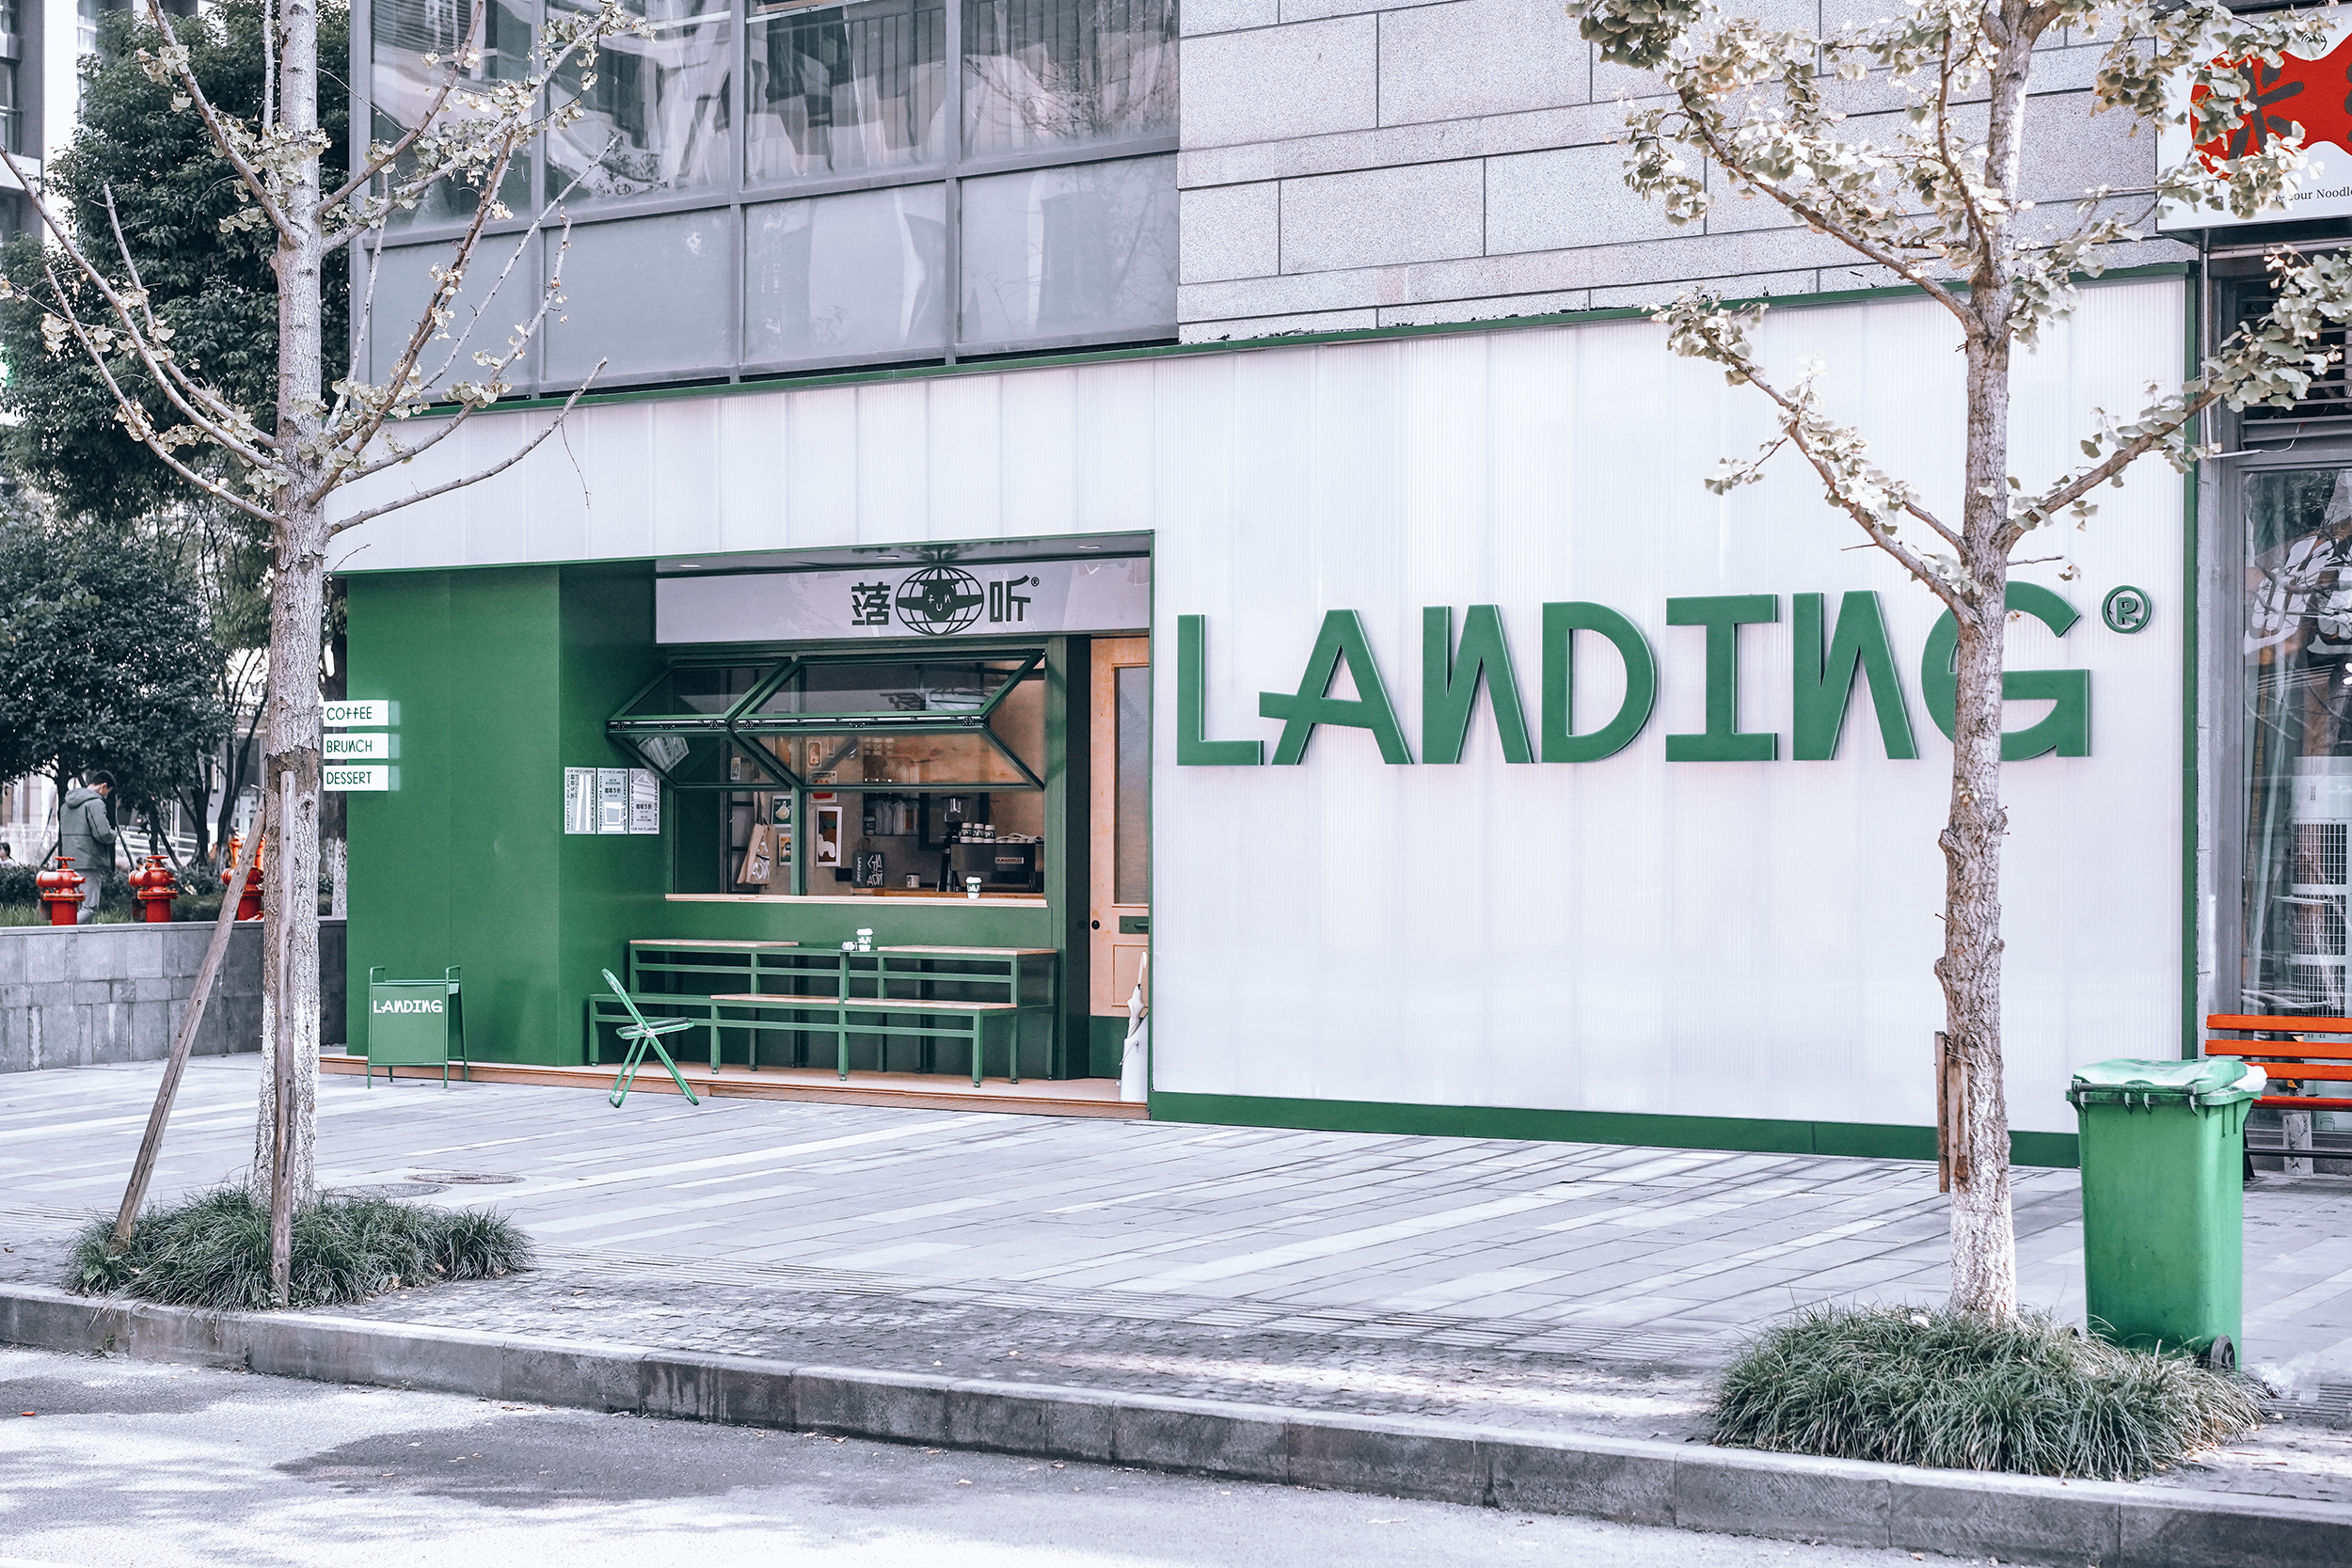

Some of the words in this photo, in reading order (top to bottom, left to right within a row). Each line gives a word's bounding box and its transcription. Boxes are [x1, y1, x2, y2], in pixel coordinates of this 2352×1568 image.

[851, 581, 891, 626] 落
[990, 575, 1031, 623] 听
[1177, 581, 2090, 767] LANDING
[326, 706, 373, 721] COFFEE
[326, 739, 373, 752] BRUNCH
[326, 771, 373, 784] DESSERT
[373, 1000, 443, 1014] LANDING
